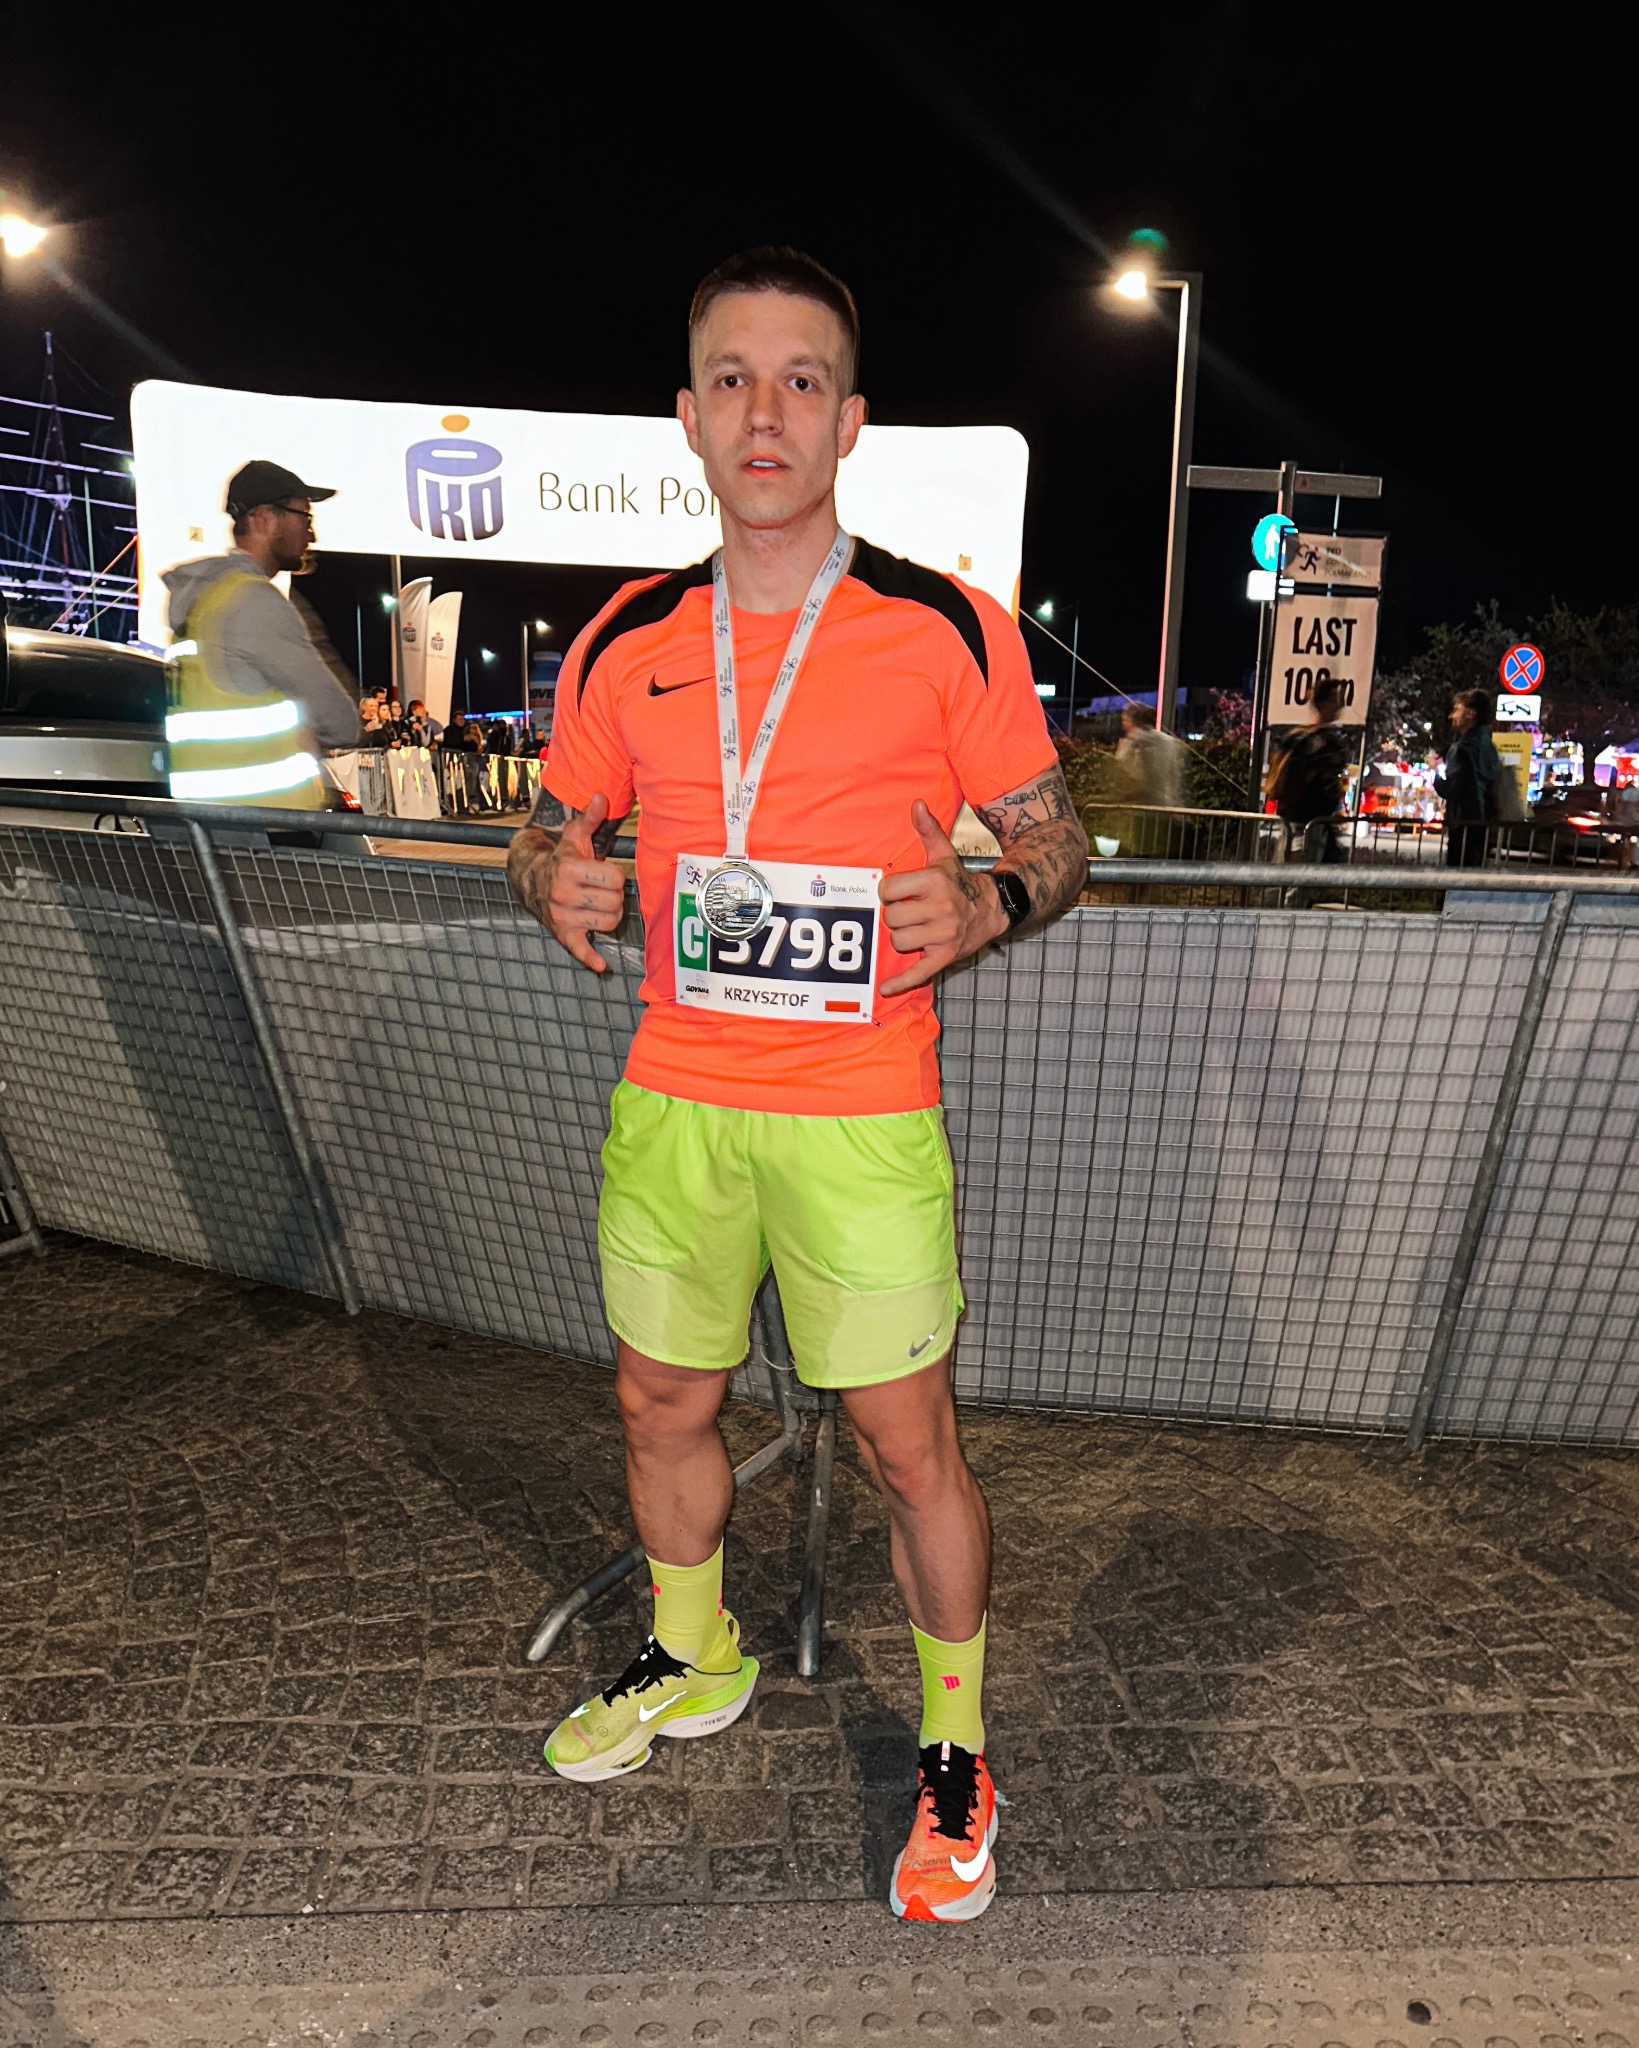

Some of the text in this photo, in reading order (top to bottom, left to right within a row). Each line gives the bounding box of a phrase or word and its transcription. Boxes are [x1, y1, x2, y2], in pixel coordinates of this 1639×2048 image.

[405, 438, 504, 542] PKO
[539, 471, 715, 516] Bank Pol
[1292, 617, 1357, 656] LAST
[810, 880, 826, 897] PKO
[831, 885, 847, 893] Bank
[682, 916, 704, 959] C
[724, 986, 809, 1007] KRZYSZTOF
